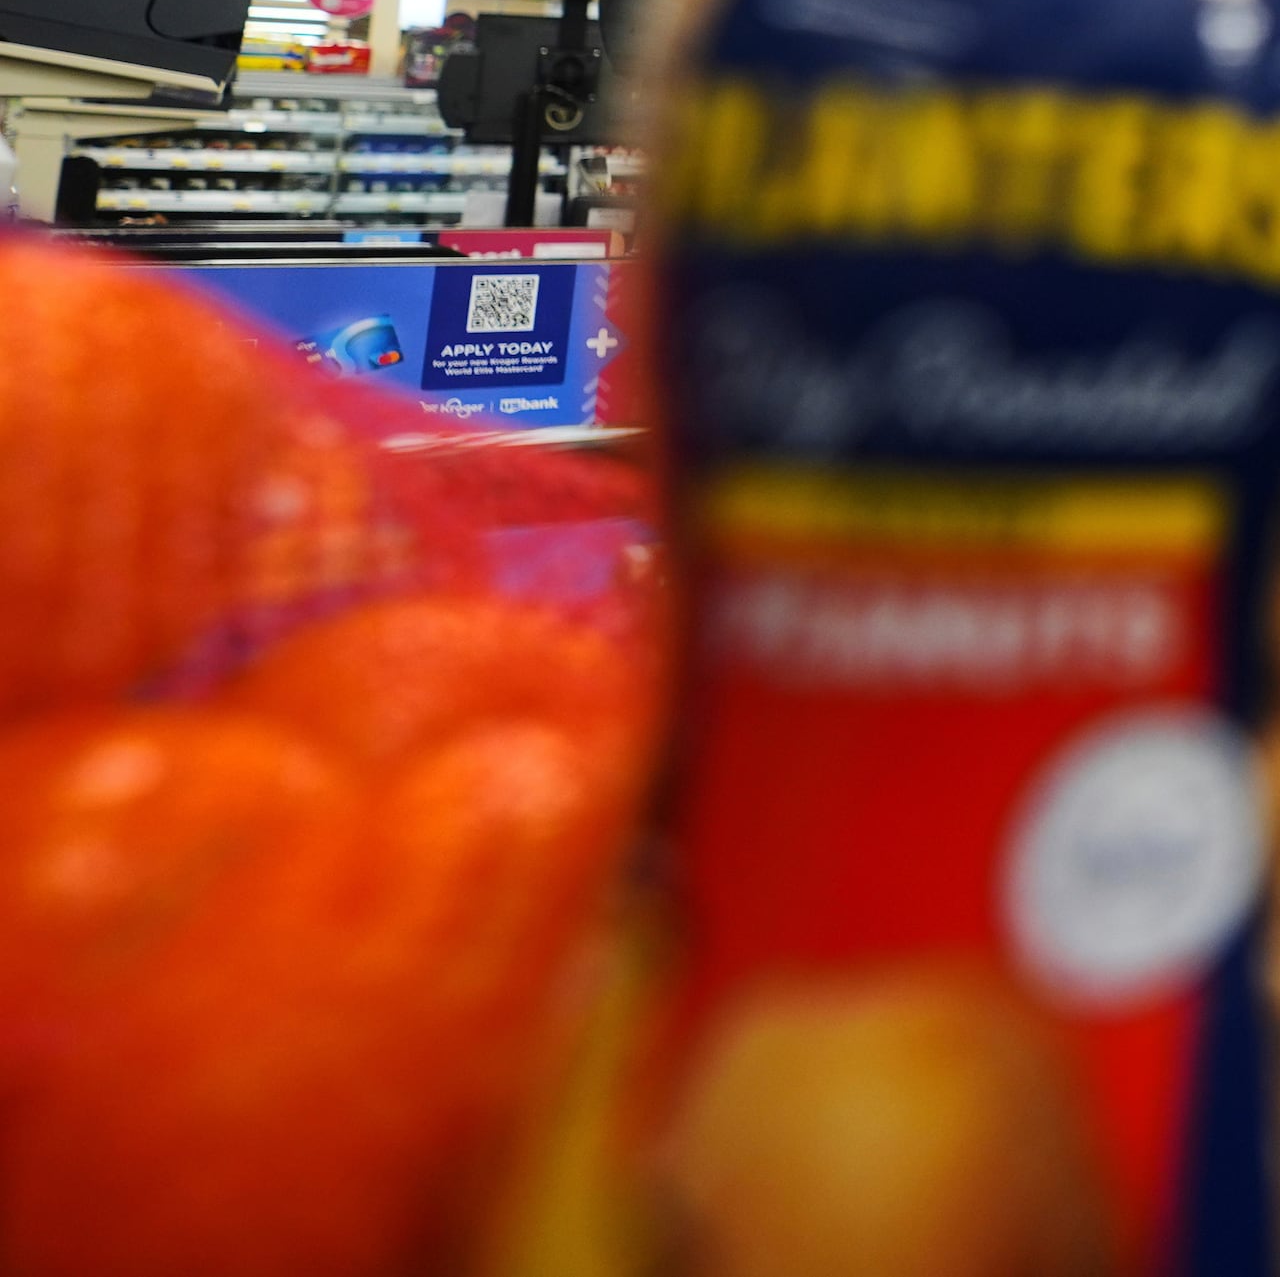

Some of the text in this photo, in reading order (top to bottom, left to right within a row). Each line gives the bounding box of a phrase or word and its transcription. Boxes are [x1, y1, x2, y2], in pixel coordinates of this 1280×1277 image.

[440, 341, 554, 358] APPLY TODAY
[440, 397, 485, 419] Kroger
